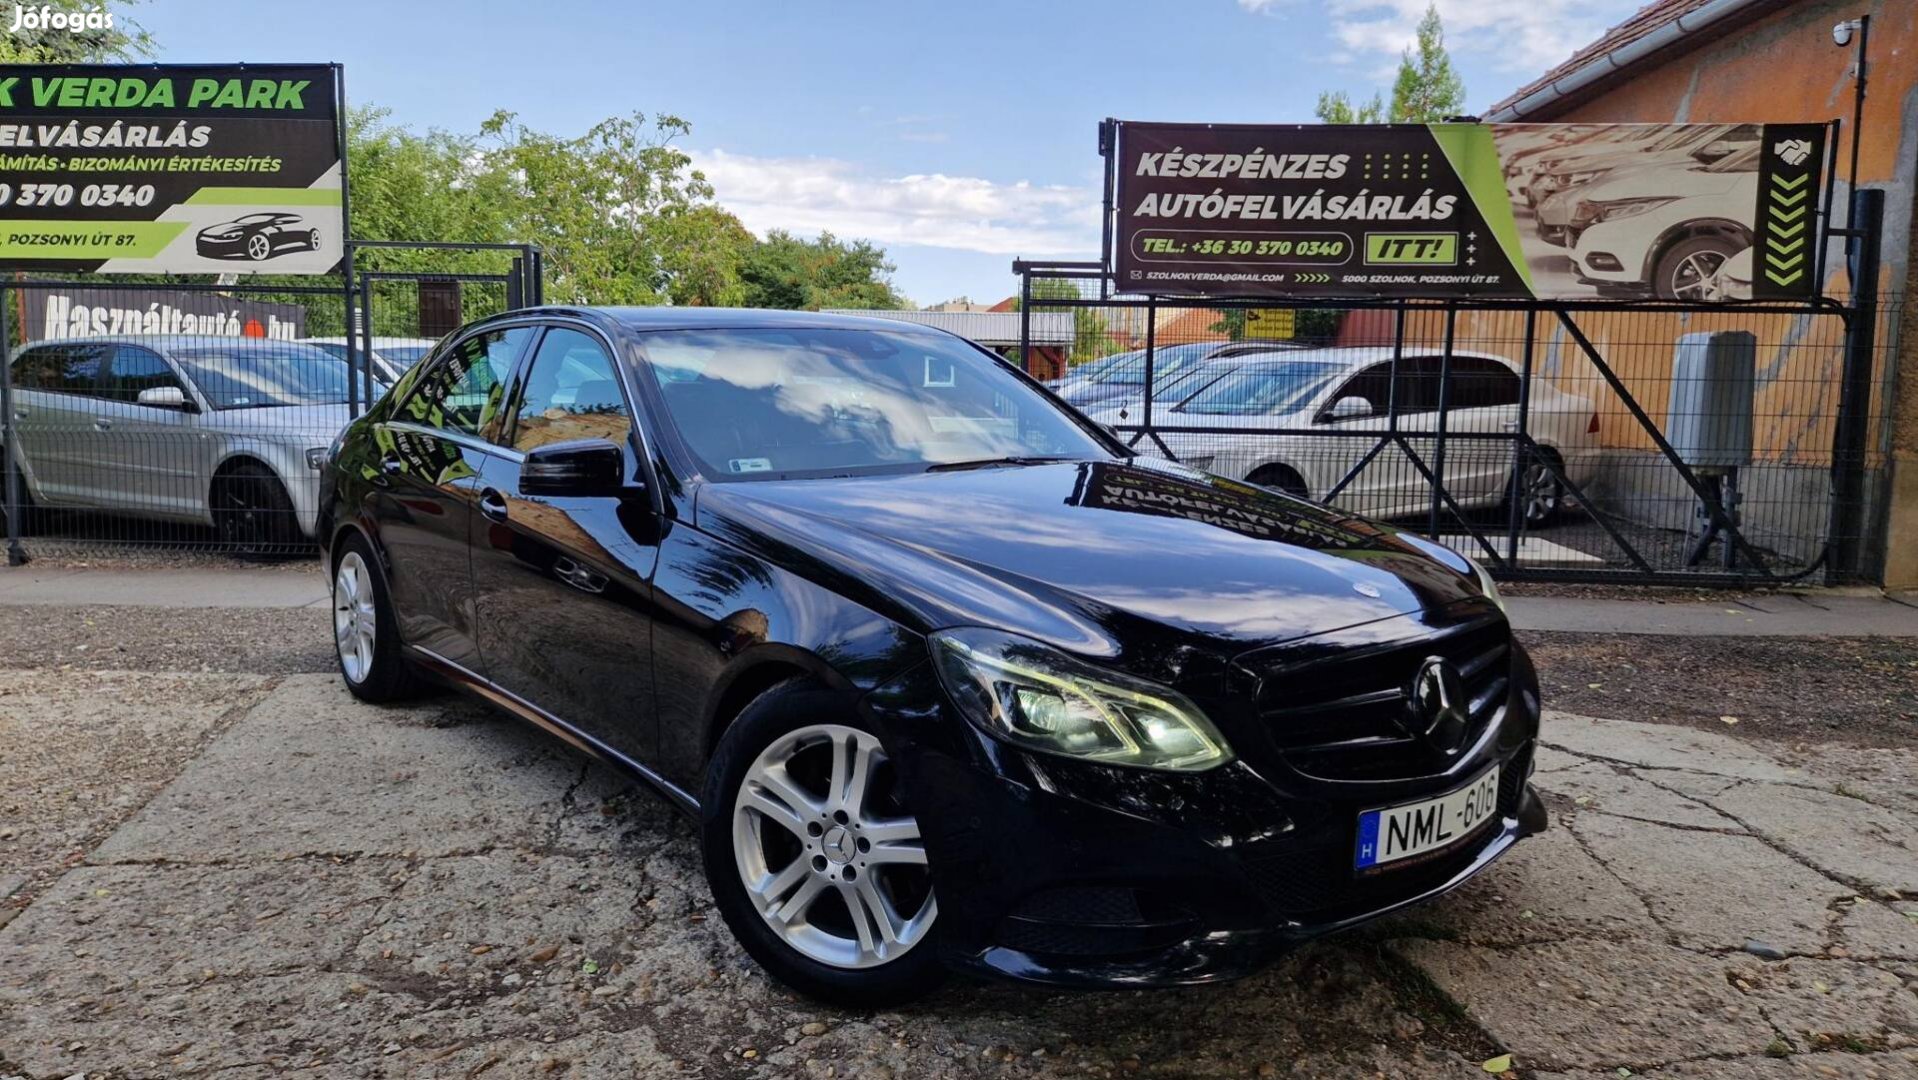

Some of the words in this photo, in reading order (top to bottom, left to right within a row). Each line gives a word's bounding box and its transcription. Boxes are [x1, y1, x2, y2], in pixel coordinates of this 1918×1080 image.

[31, 77, 175, 109] VERDA
[188, 79, 311, 110] PARK
[0, 119, 212, 148] ELVÁSÁRLÁS
[68, 154, 166, 172] BIZOMÁNYI
[167, 155, 282, 172] ÉRTÉKESÍTÉS
[1136, 146, 1350, 179] KÉSZPÉNZES
[16, 184, 74, 206] 370
[80, 184, 156, 207] 0340
[1133, 188, 1457, 220] AUTÓFELVÁSÁRLÁS
[8, 233, 87, 246] POZSONYI
[91, 231, 112, 246] ÚT
[115, 234, 137, 247] 87.
[1143, 238, 1187, 253] TEL.:
[1192, 240, 1226, 254] +36
[1227, 241, 1253, 255] 30
[1255, 241, 1292, 256] 370
[1296, 241, 1344, 256] 0340
[1377, 239, 1445, 259] ITT!
[1146, 271, 1285, 283] SZOLNOKVERDA@GMAIL.COM
[1342, 274, 1367, 283] 5000
[1419, 275, 1469, 284] POZSONYI
[1361, 843, 1373, 858] H
